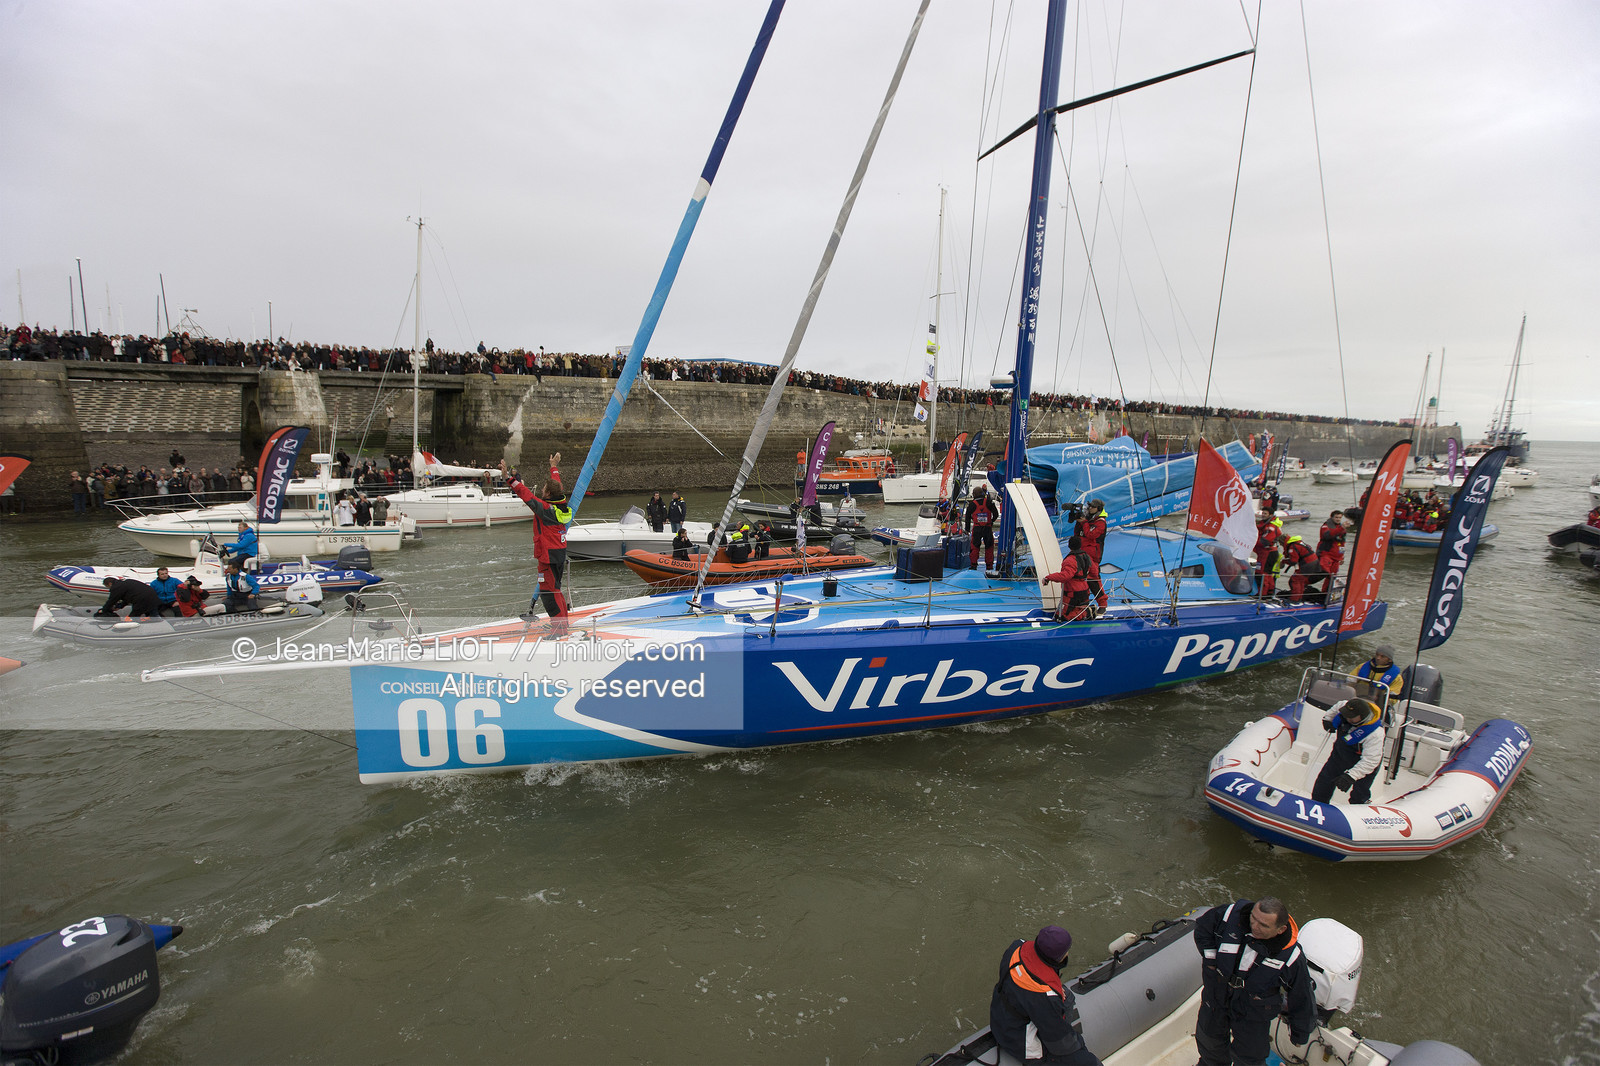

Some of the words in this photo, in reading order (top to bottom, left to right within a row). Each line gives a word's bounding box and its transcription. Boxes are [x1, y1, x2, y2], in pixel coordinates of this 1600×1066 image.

[263, 457, 289, 519] ZODIAC
[1377, 471, 1399, 496] 14
[1428, 515, 1477, 637] ZODIAC
[1162, 618, 1335, 674] Paprec
[380, 681, 441, 694] CONSEIL
[772, 657, 1094, 713] Virbac
[397, 698, 506, 767] 06
[1485, 737, 1522, 783] ZODIAC
[1225, 778, 1255, 796] 14
[1295, 799, 1325, 825] 14
[60, 916, 108, 948] 23
[101, 969, 149, 999] YAMAHA
